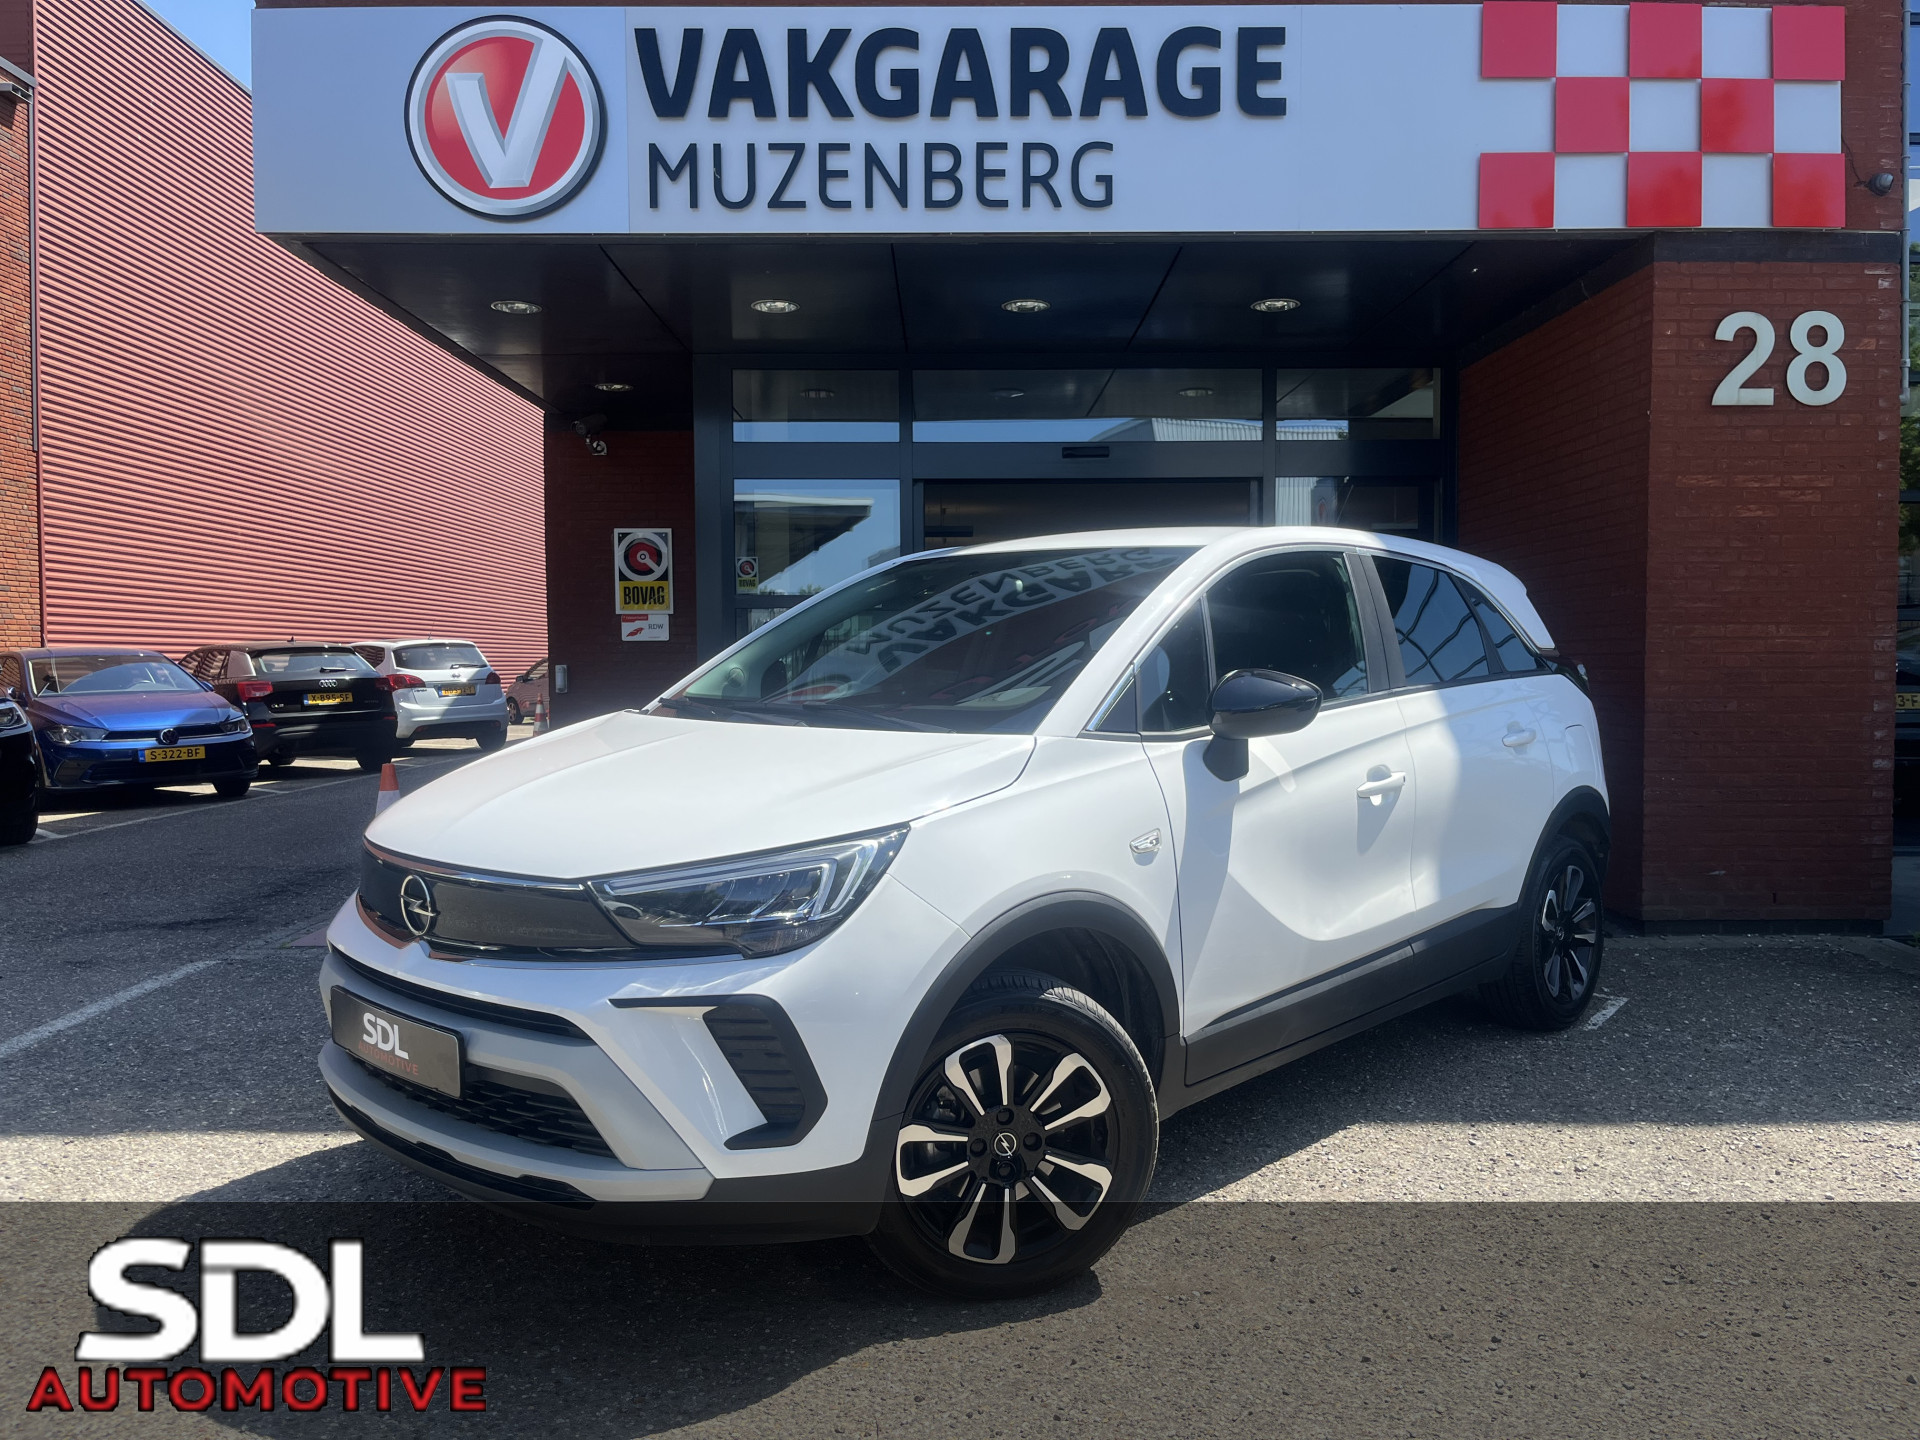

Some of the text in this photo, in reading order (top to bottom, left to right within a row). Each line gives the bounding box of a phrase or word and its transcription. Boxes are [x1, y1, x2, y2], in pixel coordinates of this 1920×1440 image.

[633, 26, 1287, 118] VAKGARAGE
[648, 141, 1114, 209] MUZENBERG
[1711, 310, 1848, 406] 28
[623, 586, 665, 605] BOVAG
[311, 693, 350, 703] X-895-SF
[150, 748, 201, 760] S-322-BF
[362, 1012, 409, 1060] SDL
[358, 1040, 419, 1076] AUTOMOTIVE
